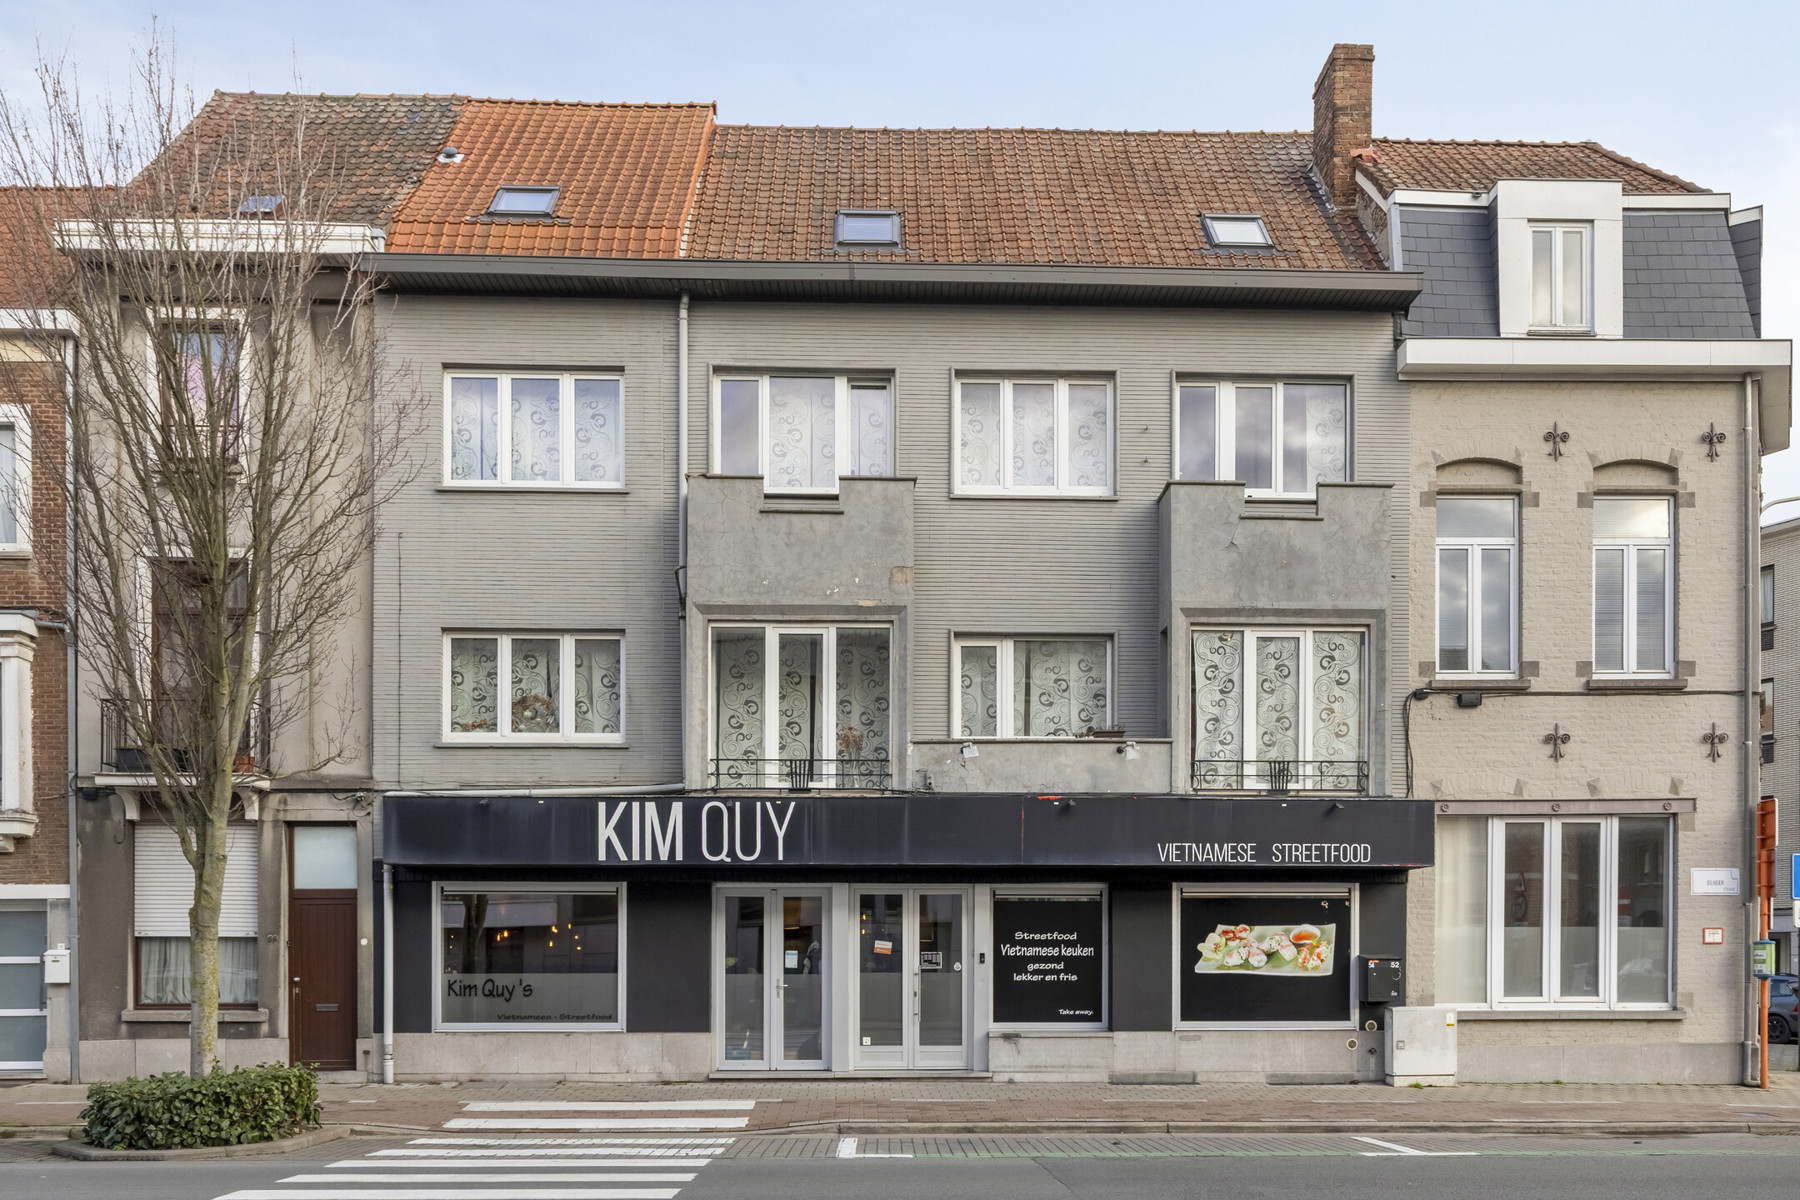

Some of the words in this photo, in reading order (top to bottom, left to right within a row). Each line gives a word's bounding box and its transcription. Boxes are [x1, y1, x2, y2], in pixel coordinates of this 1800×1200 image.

[598, 801, 684, 861] KIM
[701, 801, 796, 862] QUY
[1157, 843, 1257, 863] VIETNAMESE
[1272, 843, 1371, 863] STREETFOOD
[1014, 931, 1078, 940] Streetfood
[1000, 944, 1060, 956] Vietnamese
[1061, 944, 1095, 956] keuken
[1027, 962, 1064, 971] gezond
[1013, 973, 1044, 981] lekker
[1060, 973, 1078, 981] fris
[447, 978, 478, 998] Kim
